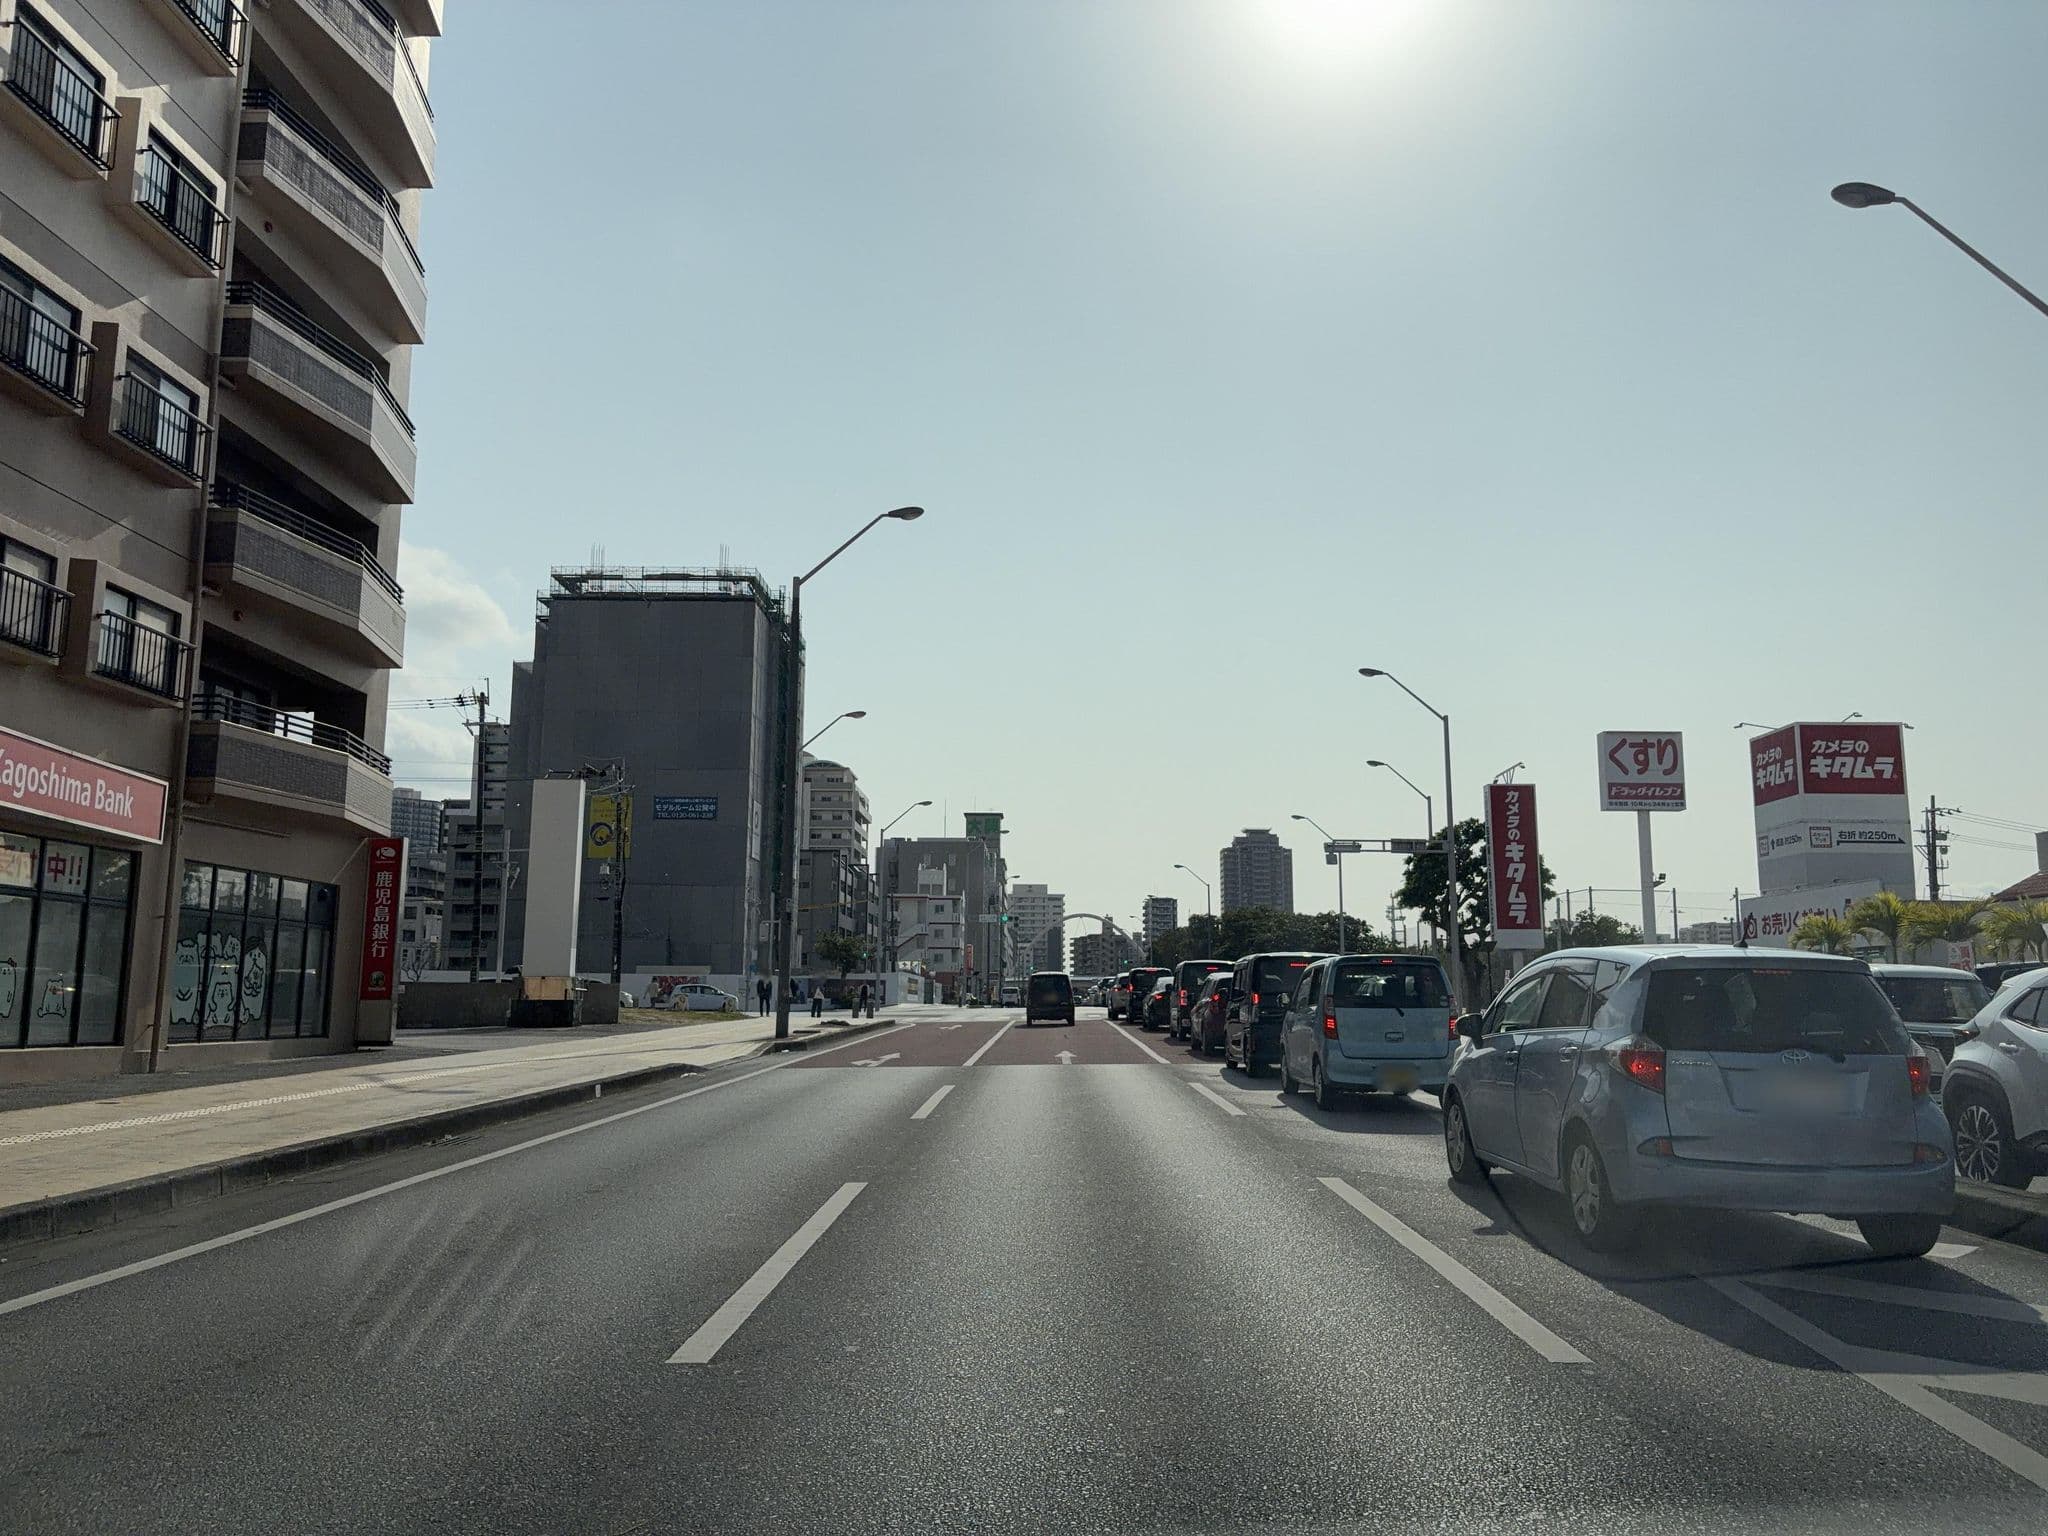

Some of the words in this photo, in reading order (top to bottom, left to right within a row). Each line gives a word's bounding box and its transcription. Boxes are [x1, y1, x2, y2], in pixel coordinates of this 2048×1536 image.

[1608, 738, 1679, 775] くすり
[1755, 746, 1782, 767] カメラの
[1810, 740, 1869, 754] カメラの
[1755, 758, 1794, 789] キタムラ
[1809, 755, 1895, 779] キタムラ
[94, 778, 134, 818] Bank
[1610, 786, 1682, 796] ドラッグイレブン
[1838, 831, 1858, 840] 右折
[1505, 790, 1528, 925] カメラのキタムラ
[371, 871, 393, 958] 鹿児島銀行
